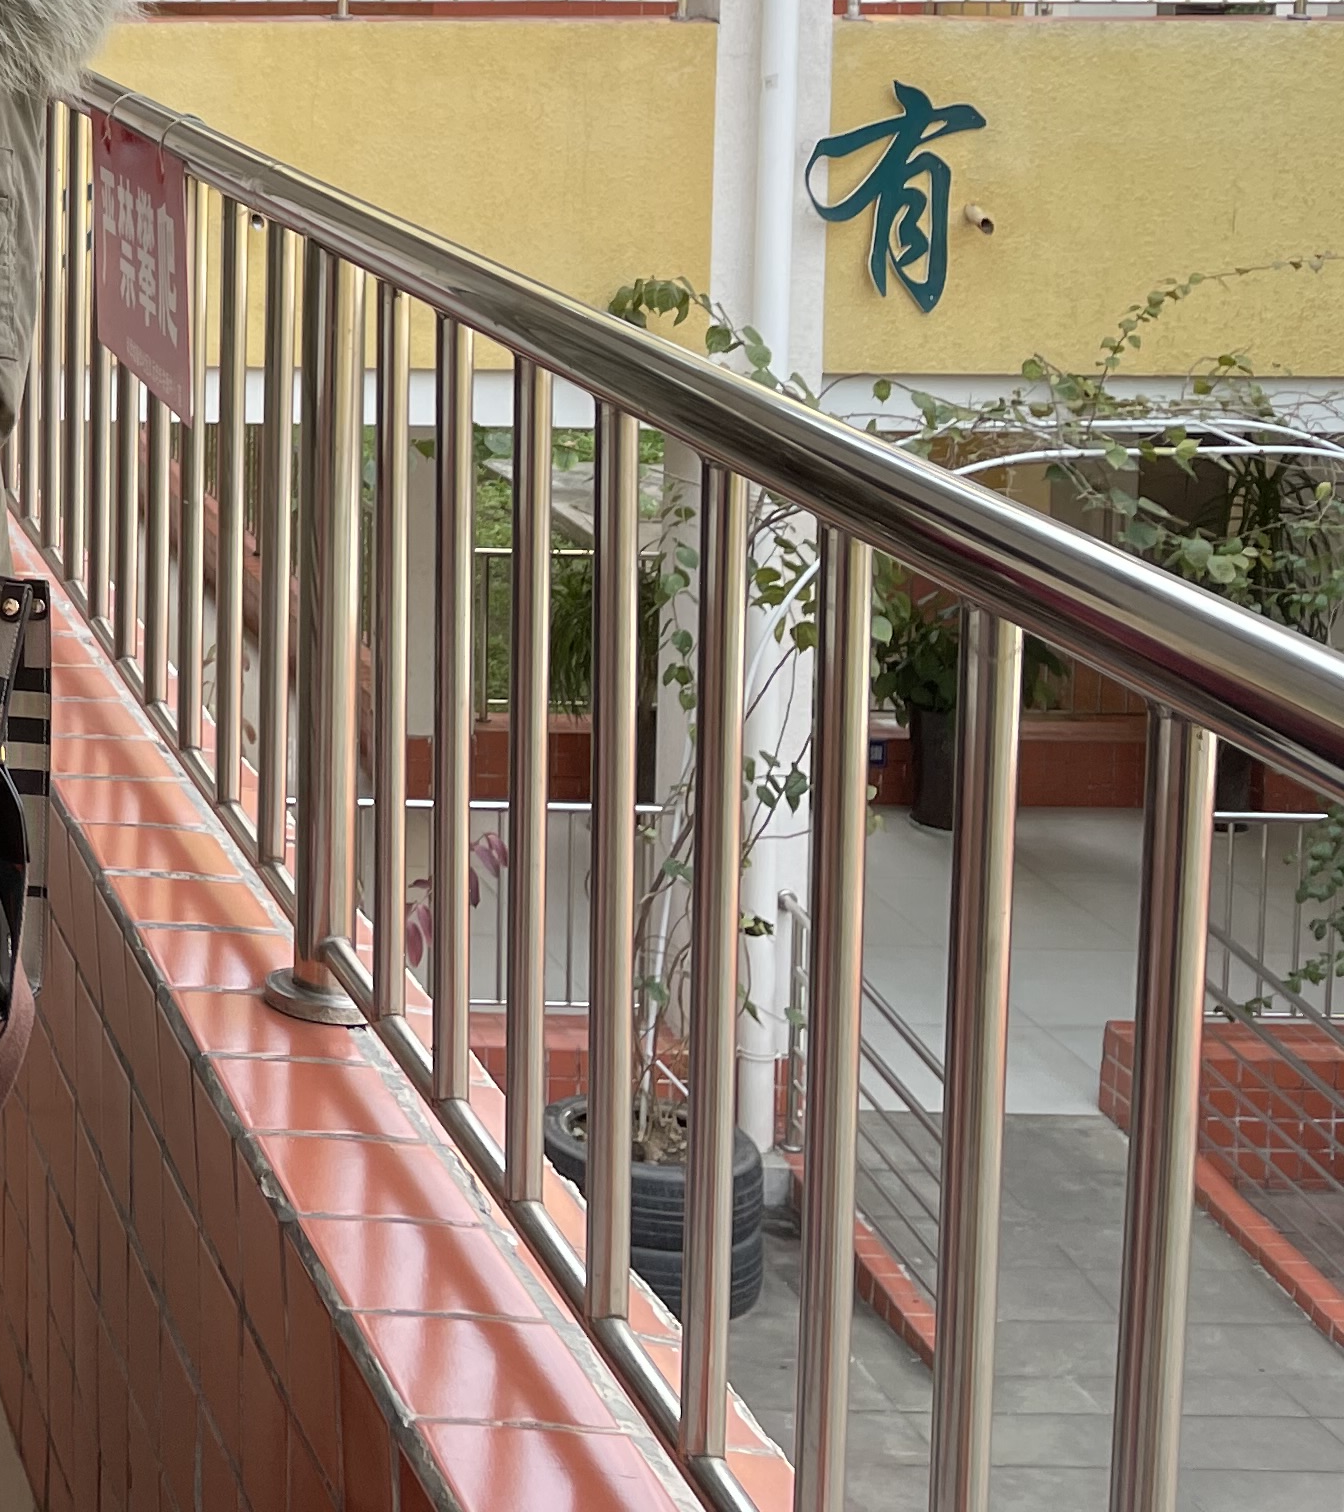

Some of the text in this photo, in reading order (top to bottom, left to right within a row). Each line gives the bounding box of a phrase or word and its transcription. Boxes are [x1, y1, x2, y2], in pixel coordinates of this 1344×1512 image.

[100, 165, 178, 348] 严禁攀爬
[805, 79, 987, 313] 有
